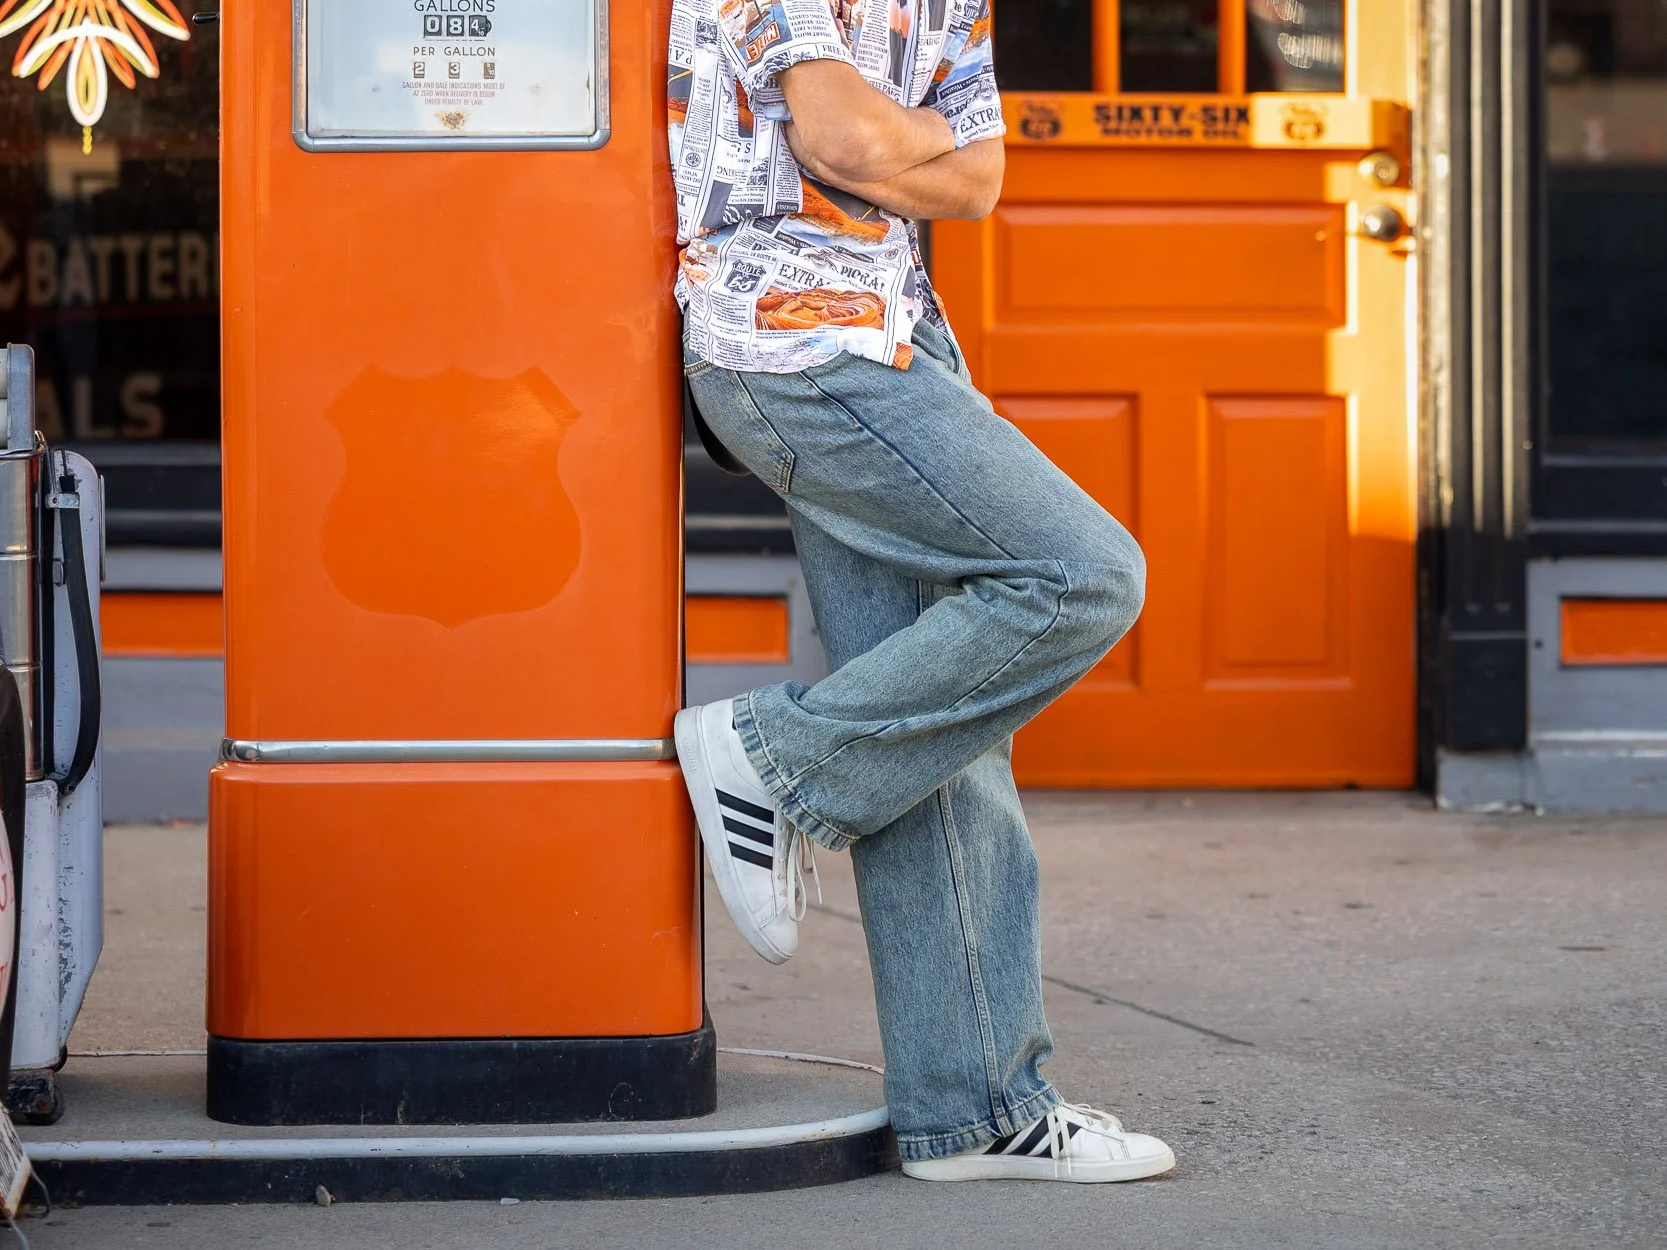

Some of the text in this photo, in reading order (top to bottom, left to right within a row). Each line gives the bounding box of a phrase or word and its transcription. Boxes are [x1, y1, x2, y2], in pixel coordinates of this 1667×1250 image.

[413, 47, 495, 56] PER GALLON
[736, 262, 761, 275] ROUTE
